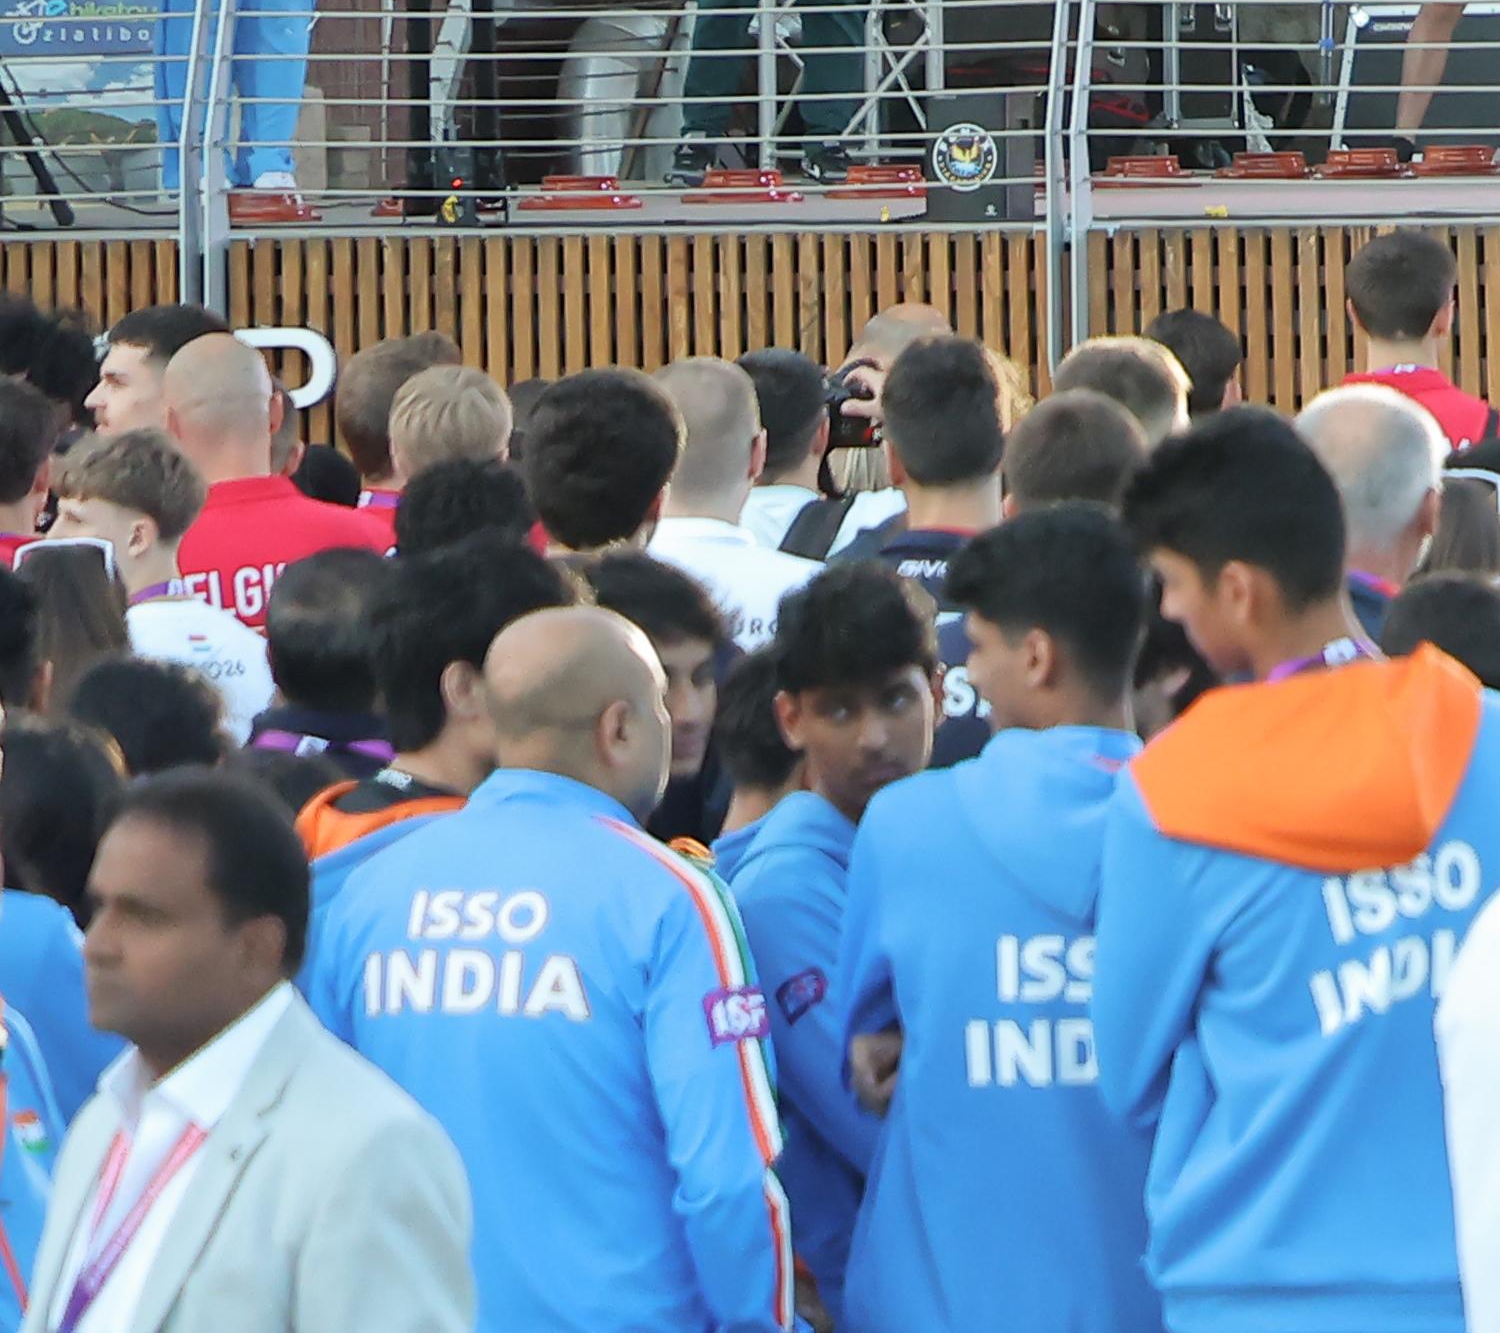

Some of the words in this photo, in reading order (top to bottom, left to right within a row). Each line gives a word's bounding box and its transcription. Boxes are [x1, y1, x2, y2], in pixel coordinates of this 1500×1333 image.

[43, 26, 150, 42] zlatibo
[407, 889, 550, 944] ISSO
[1321, 841, 1480, 945] ISSO
[363, 947, 590, 1021] INDIA
[996, 934, 1095, 1003] ISS
[1310, 929, 1462, 1037] INDI
[966, 1018, 1099, 1087] IND
